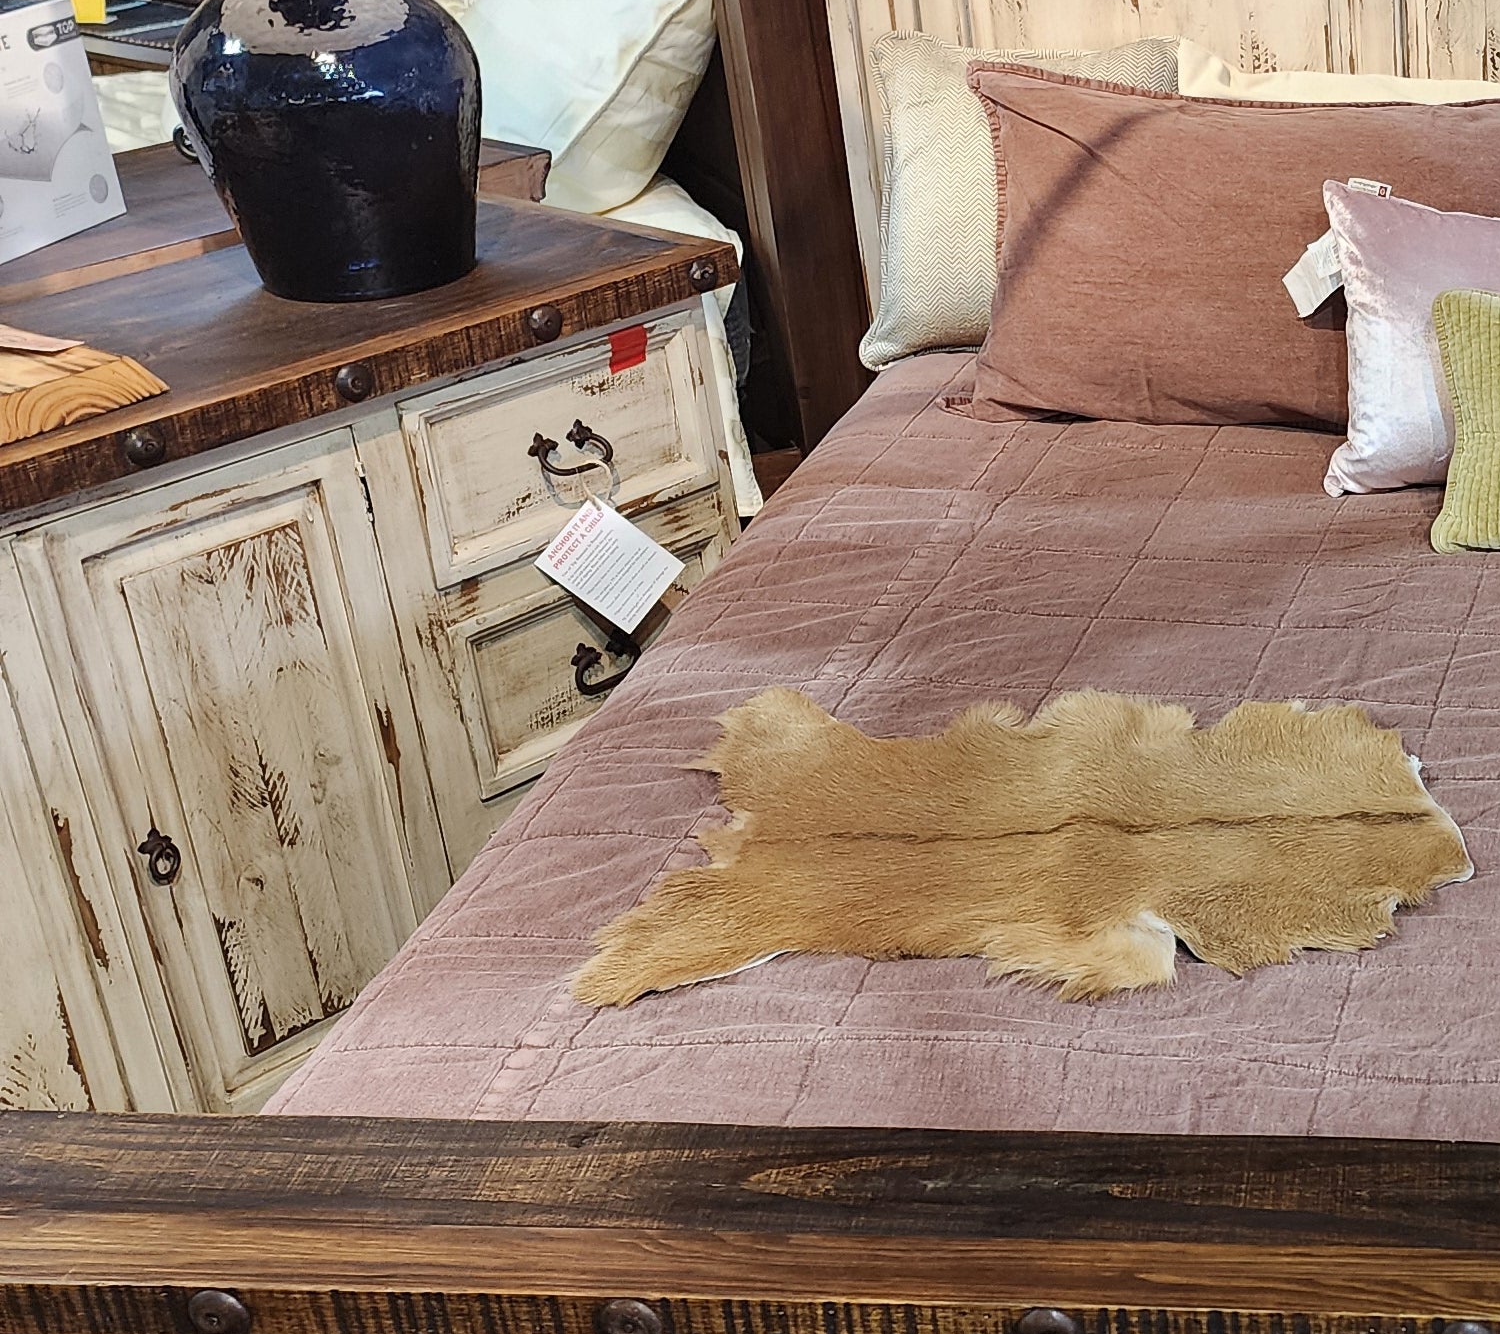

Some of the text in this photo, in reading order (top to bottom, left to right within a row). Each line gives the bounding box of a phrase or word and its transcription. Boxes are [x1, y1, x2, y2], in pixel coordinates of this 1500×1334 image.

[547, 508, 594, 561] ANCHOR IT AND
[553, 537, 581, 570] PROTECT
[584, 511, 605, 533] CHILD
